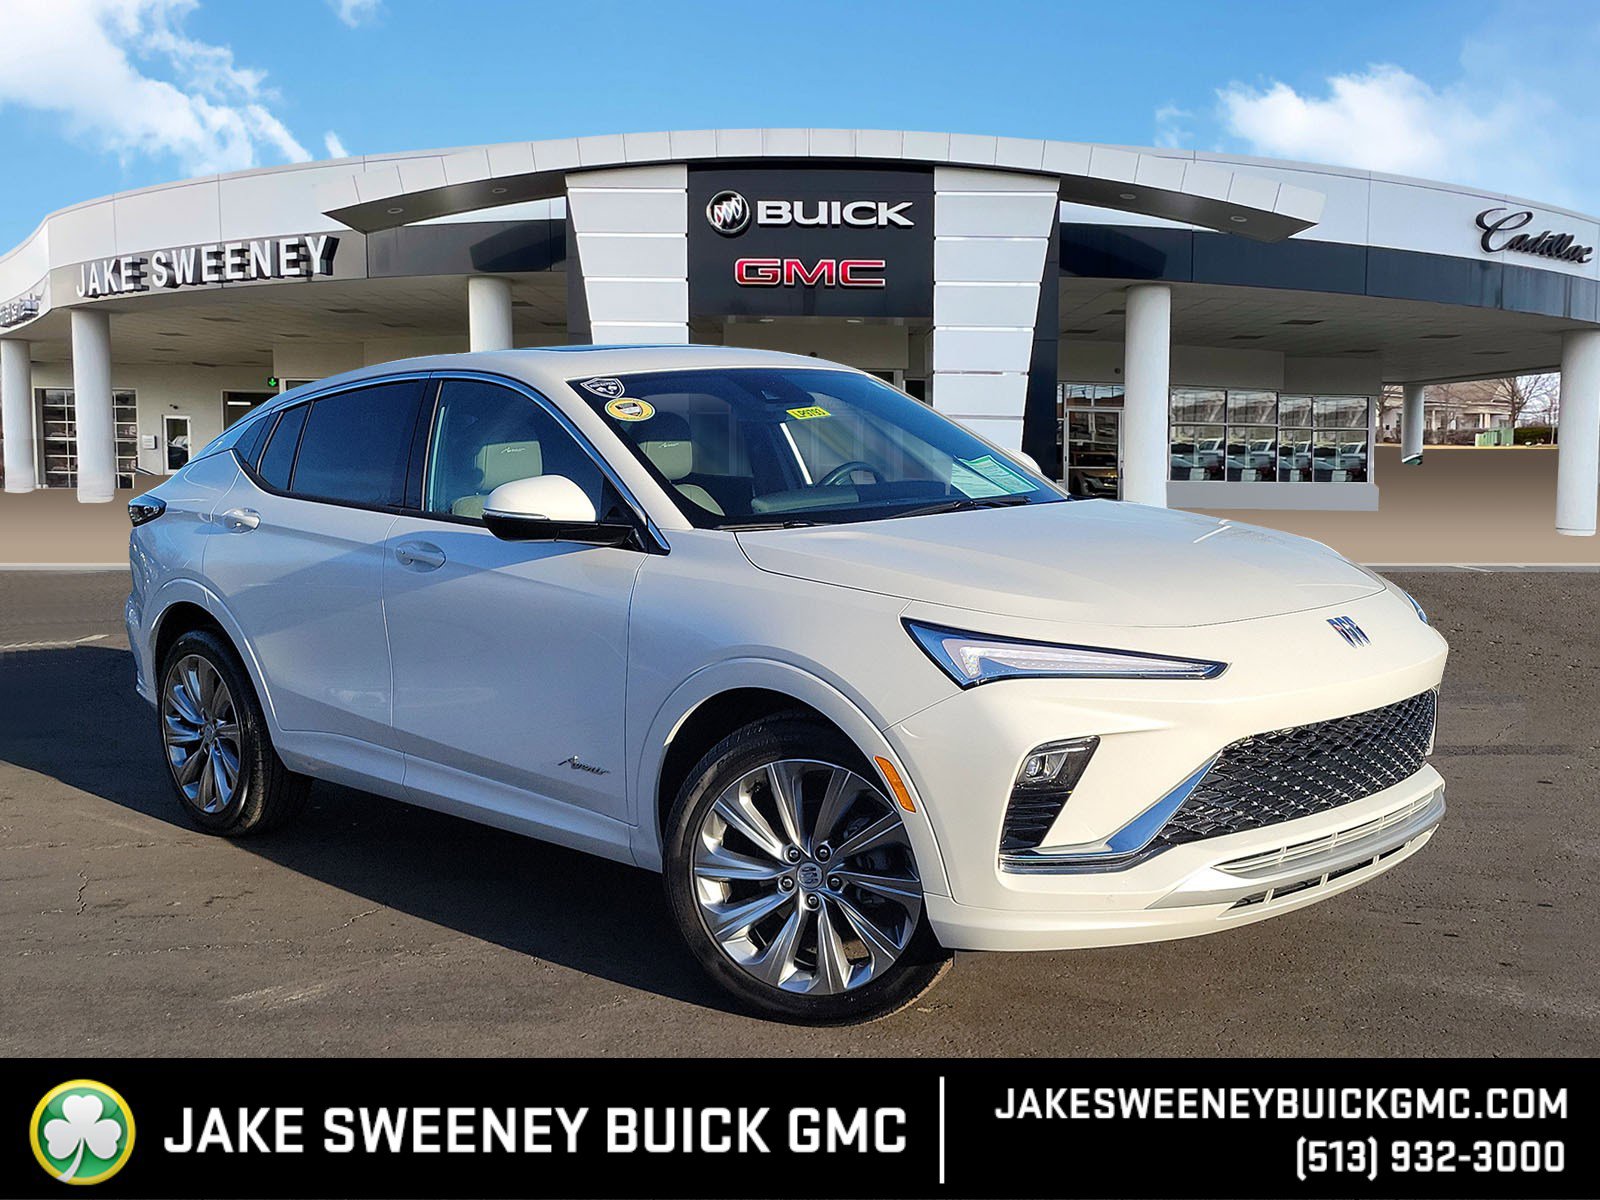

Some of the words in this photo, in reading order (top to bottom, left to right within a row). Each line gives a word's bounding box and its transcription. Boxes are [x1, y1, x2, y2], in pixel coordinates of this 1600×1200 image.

[757, 200, 915, 226] BUICK
[1475, 207, 1593, 263] Cadillac
[76, 256, 138, 298] JAKE
[151, 235, 331, 288] SWEENEY
[734, 258, 886, 287] GMC
